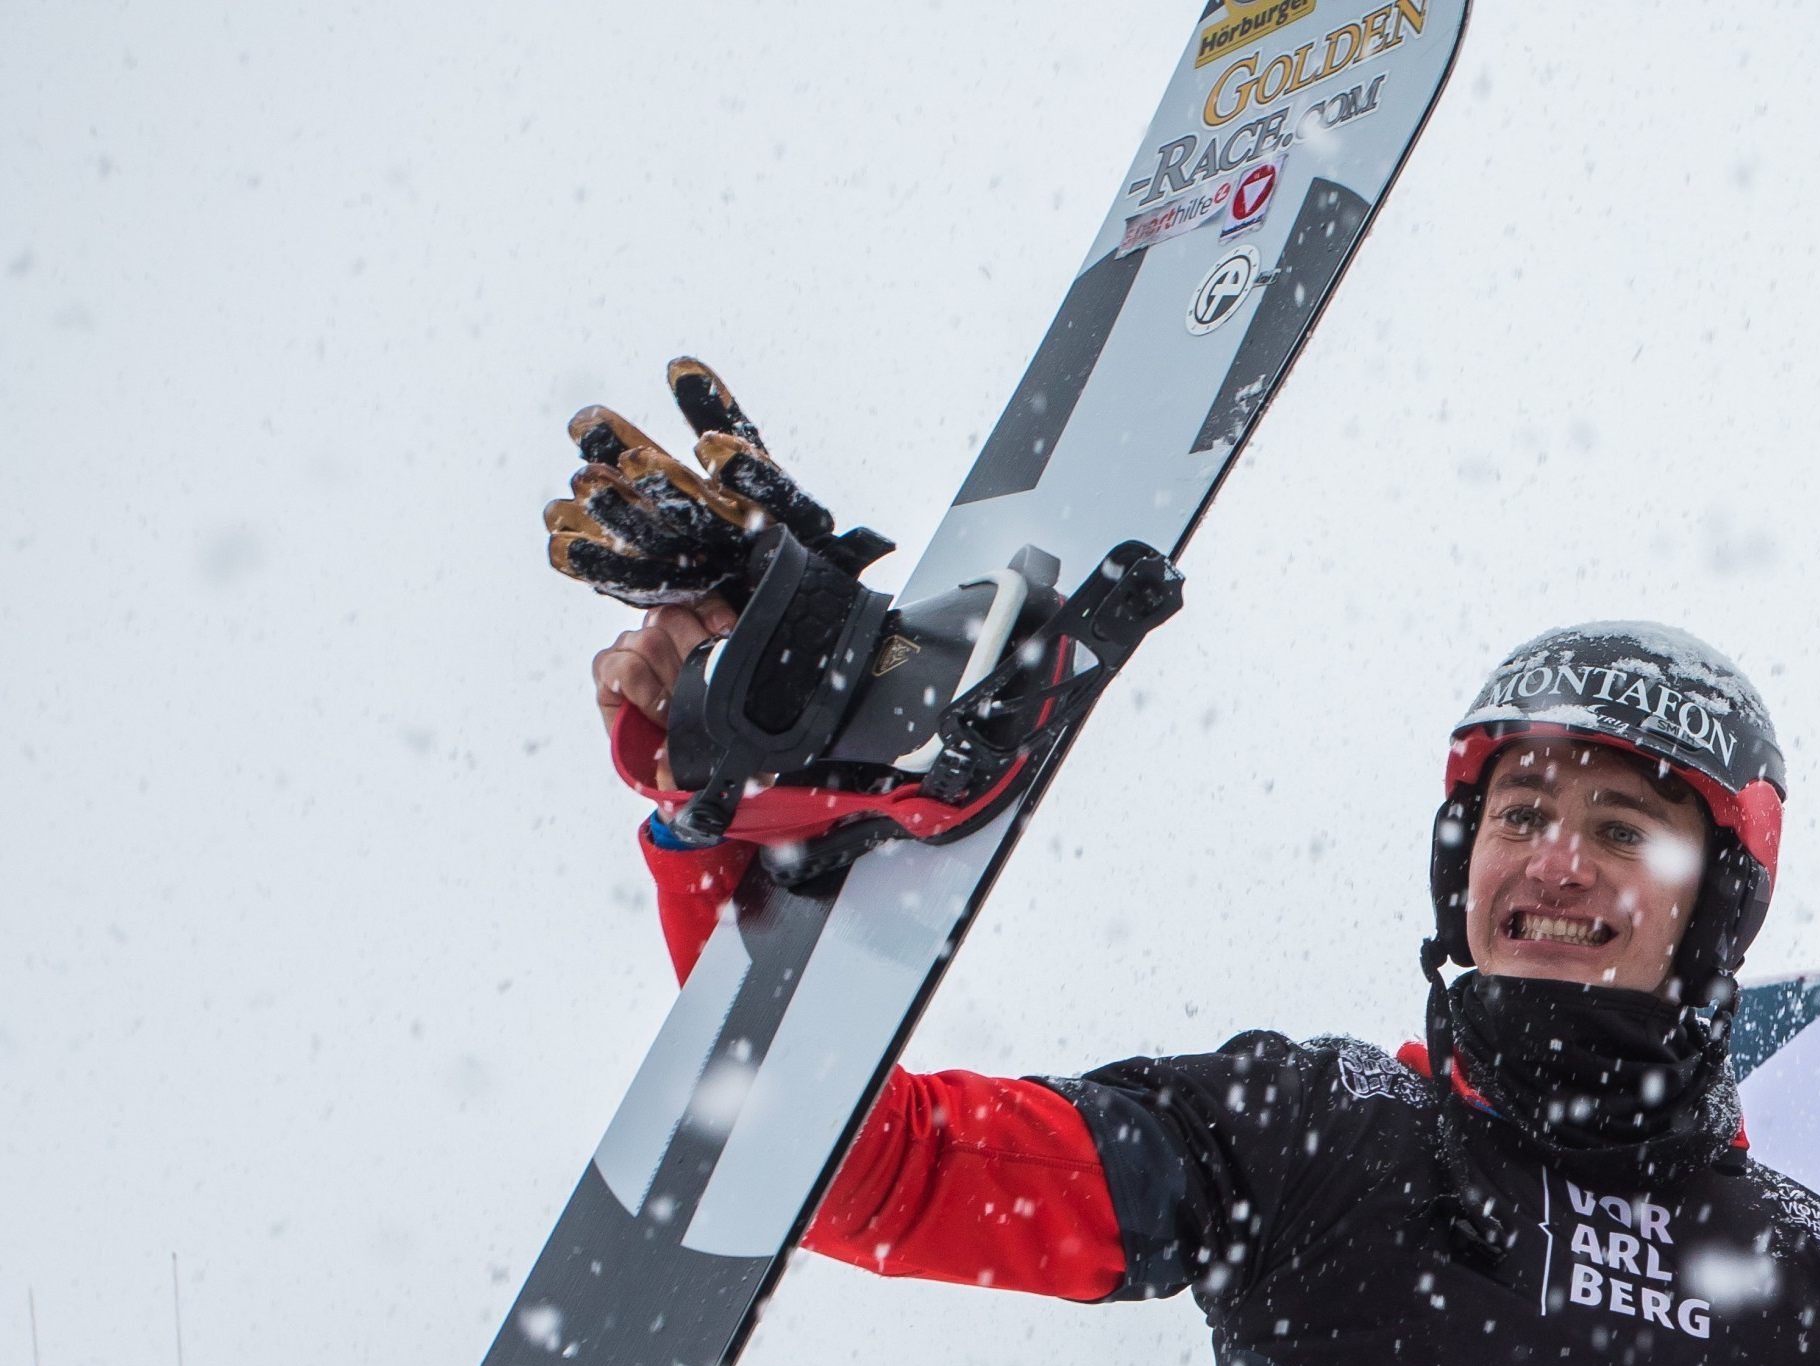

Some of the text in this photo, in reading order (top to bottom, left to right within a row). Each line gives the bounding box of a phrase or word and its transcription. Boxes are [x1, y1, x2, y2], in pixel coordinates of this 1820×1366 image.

[1488, 664, 1738, 768] MONTAFON
[1564, 1180, 1673, 1244] VOR
[1571, 1225, 1674, 1283] ARL
[1569, 1263, 1711, 1339] BERG
